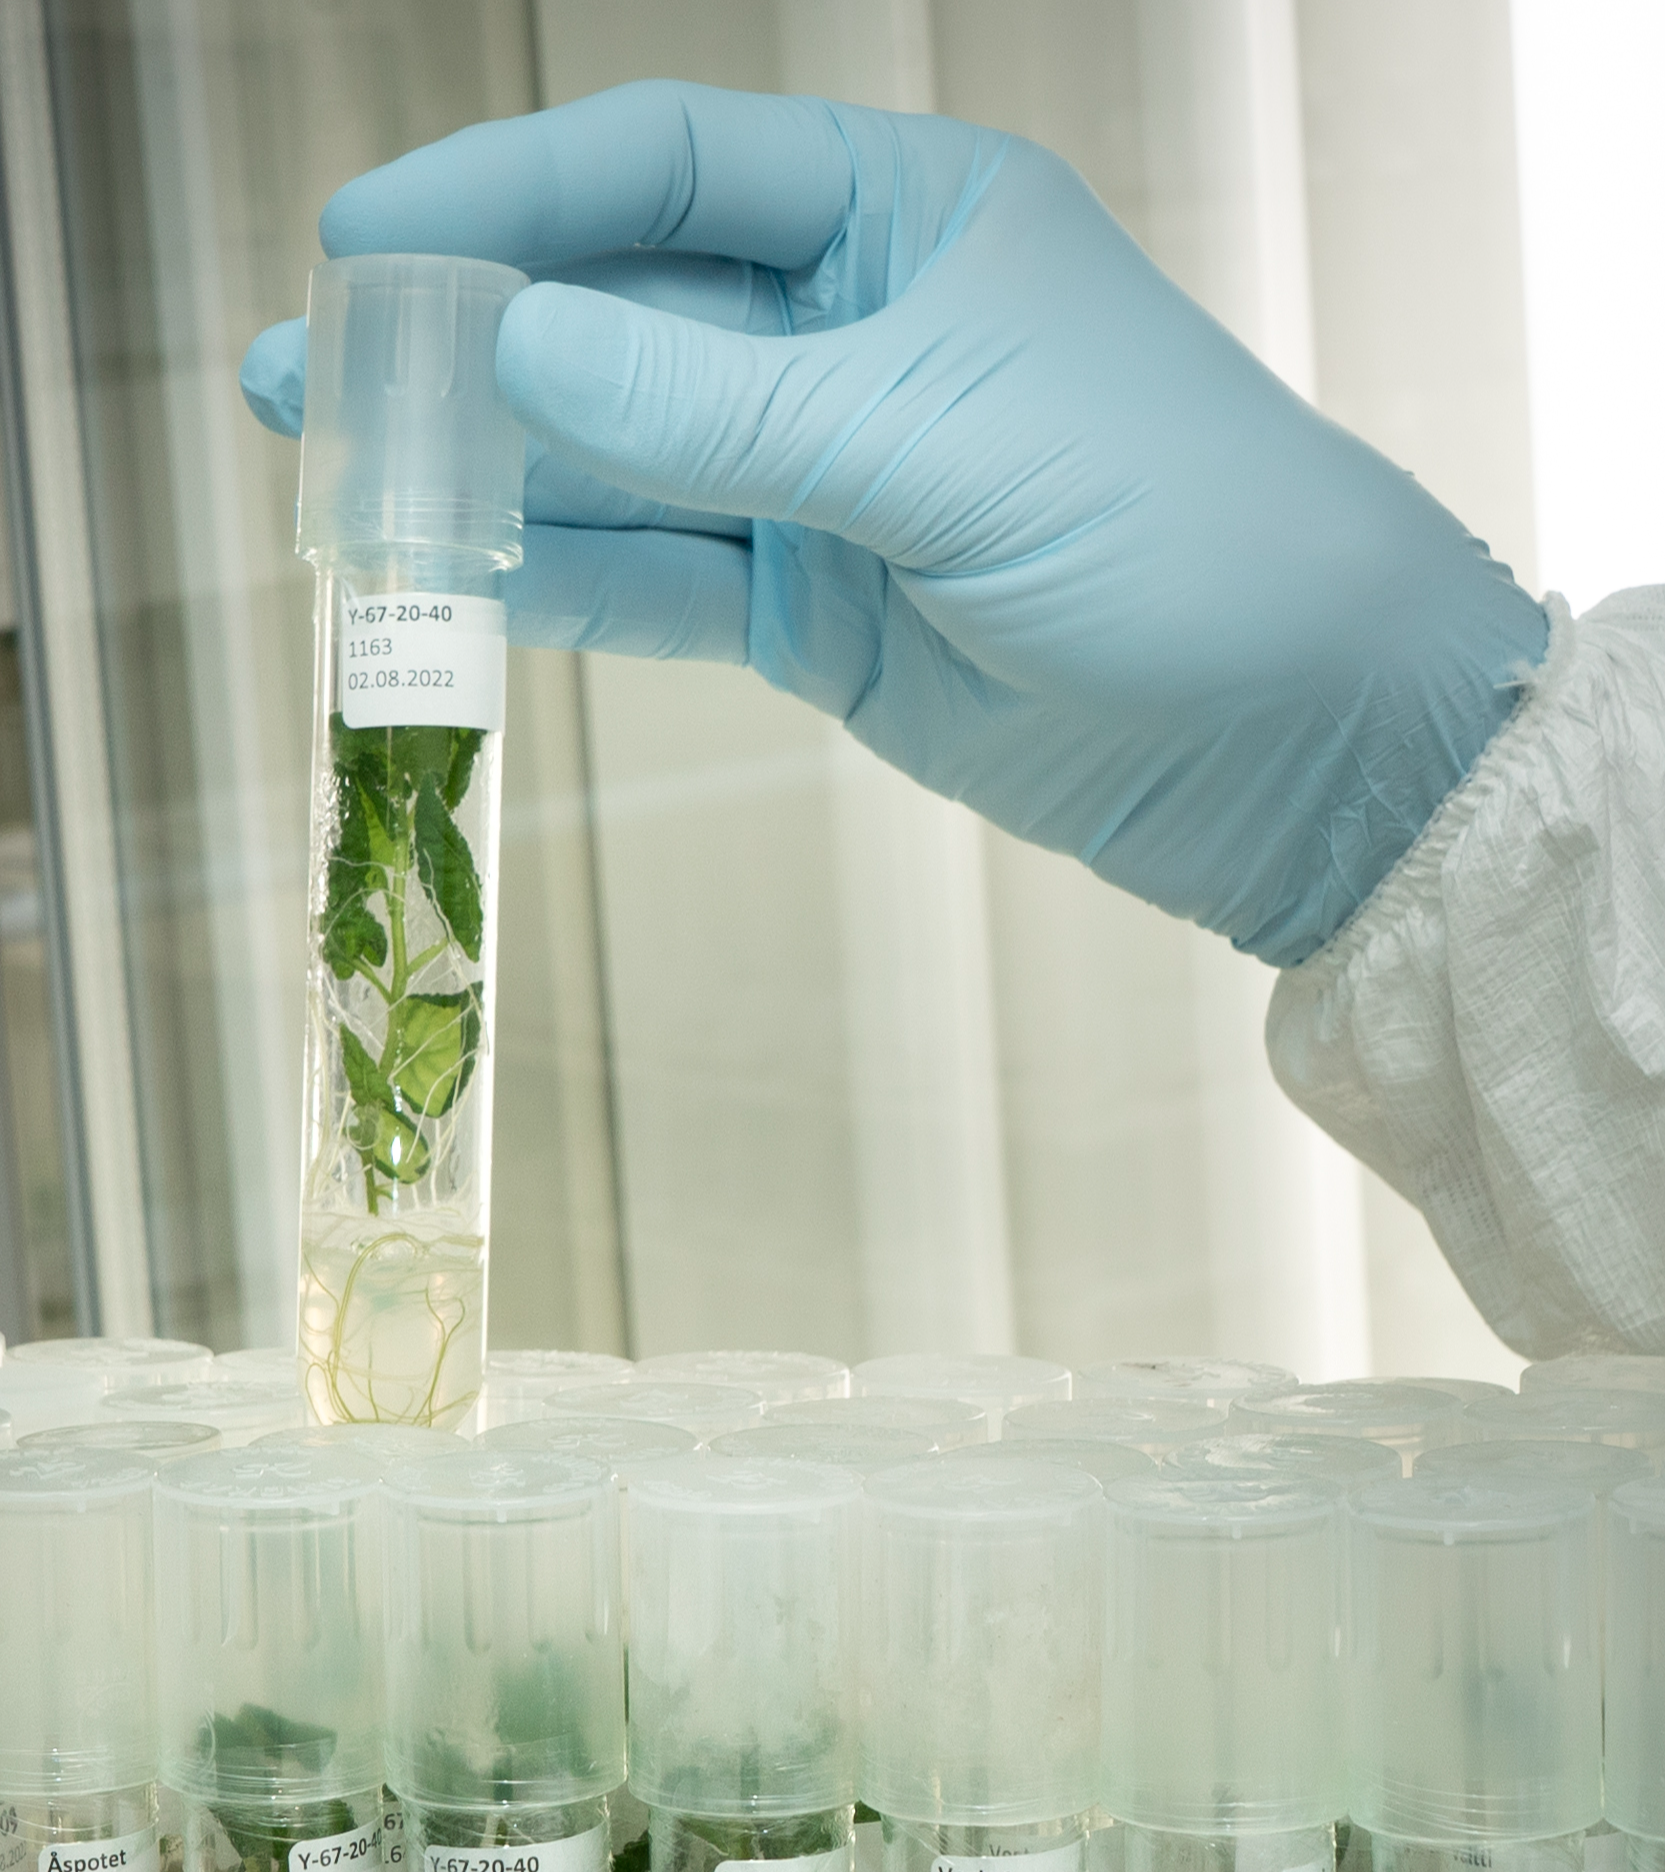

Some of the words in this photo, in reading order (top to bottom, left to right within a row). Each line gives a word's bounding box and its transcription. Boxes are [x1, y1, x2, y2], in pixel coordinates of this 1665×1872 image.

[347, 605, 453, 625] Y-67-20-40
[348, 637, 393, 658] 1163
[347, 669, 455, 690] 02.08.2022
[298, 1827, 382, 1870] Y-67-20-40
[47, 1850, 127, 1872] Åspotet
[430, 1856, 540, 1872] Y-67-20-40
